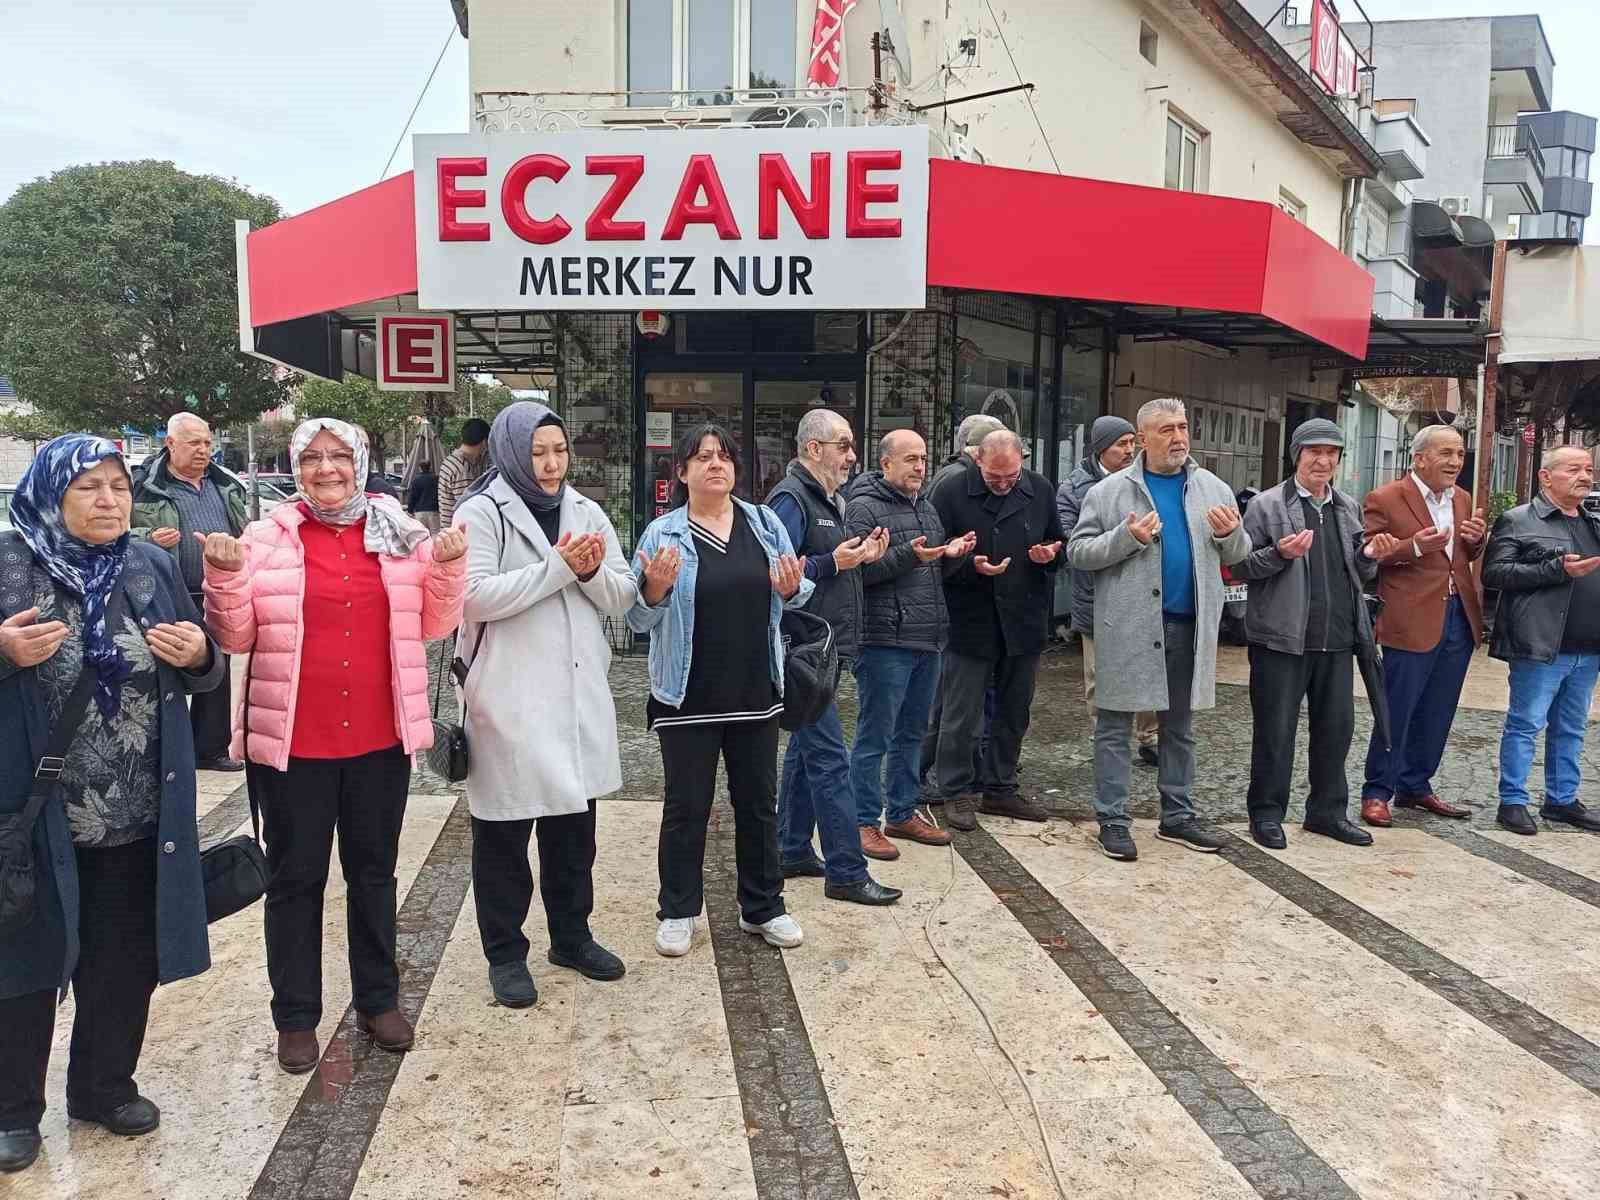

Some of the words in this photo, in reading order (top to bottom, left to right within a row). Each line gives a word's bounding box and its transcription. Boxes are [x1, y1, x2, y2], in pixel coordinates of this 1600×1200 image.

[436, 150, 902, 245] ECZANE
[519, 256, 696, 296] MERKEZ
[713, 255, 814, 296] NUR
[396, 328, 435, 373] E
[1192, 406, 1262, 447] EYDAN
